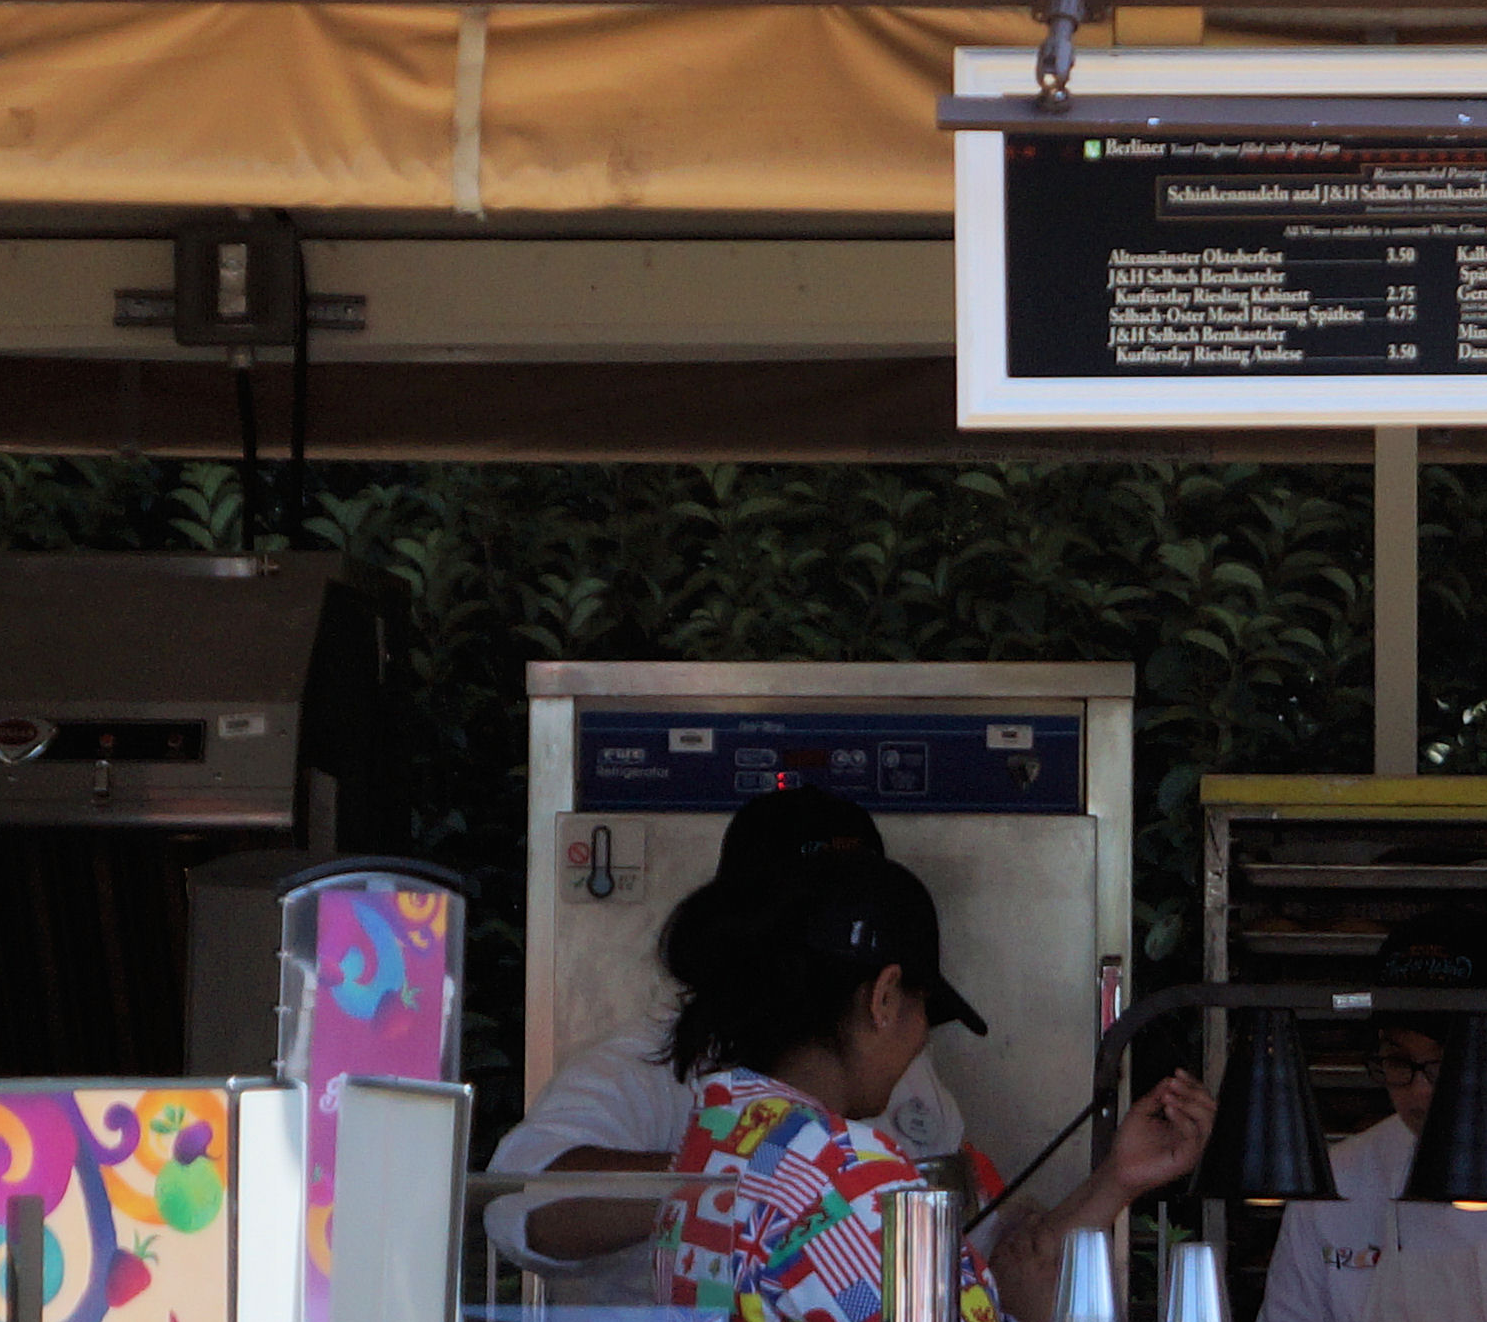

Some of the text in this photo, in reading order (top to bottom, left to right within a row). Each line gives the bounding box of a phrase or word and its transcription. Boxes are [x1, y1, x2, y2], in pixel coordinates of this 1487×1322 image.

[1106, 138, 1166, 155] Berliner
[1167, 184, 1289, 202] Schinkennudeln
[1292, 184, 1319, 201] and
[1322, 184, 1358, 204] J&H
[1360, 184, 1412, 200] Selbach
[1202, 248, 1283, 265] Oktoberfest
[1386, 247, 1415, 262] 3.50
[1107, 268, 1286, 289] J&H Selbach Bernkasteler
[1193, 286, 1250, 307] Riesling
[1251, 286, 1310, 301] Kabinett
[1386, 285, 1415, 301] 2.75
[1207, 306, 1249, 322] Mosel
[1252, 306, 1307, 327] Riesling
[1386, 305, 1415, 321] 4.75
[1107, 326, 1286, 347] J&H Selbach Bernkasteler
[1193, 346, 1250, 366] Riesling
[1251, 345, 1303, 360] Auslese
[1386, 344, 1416, 359] 3.50
